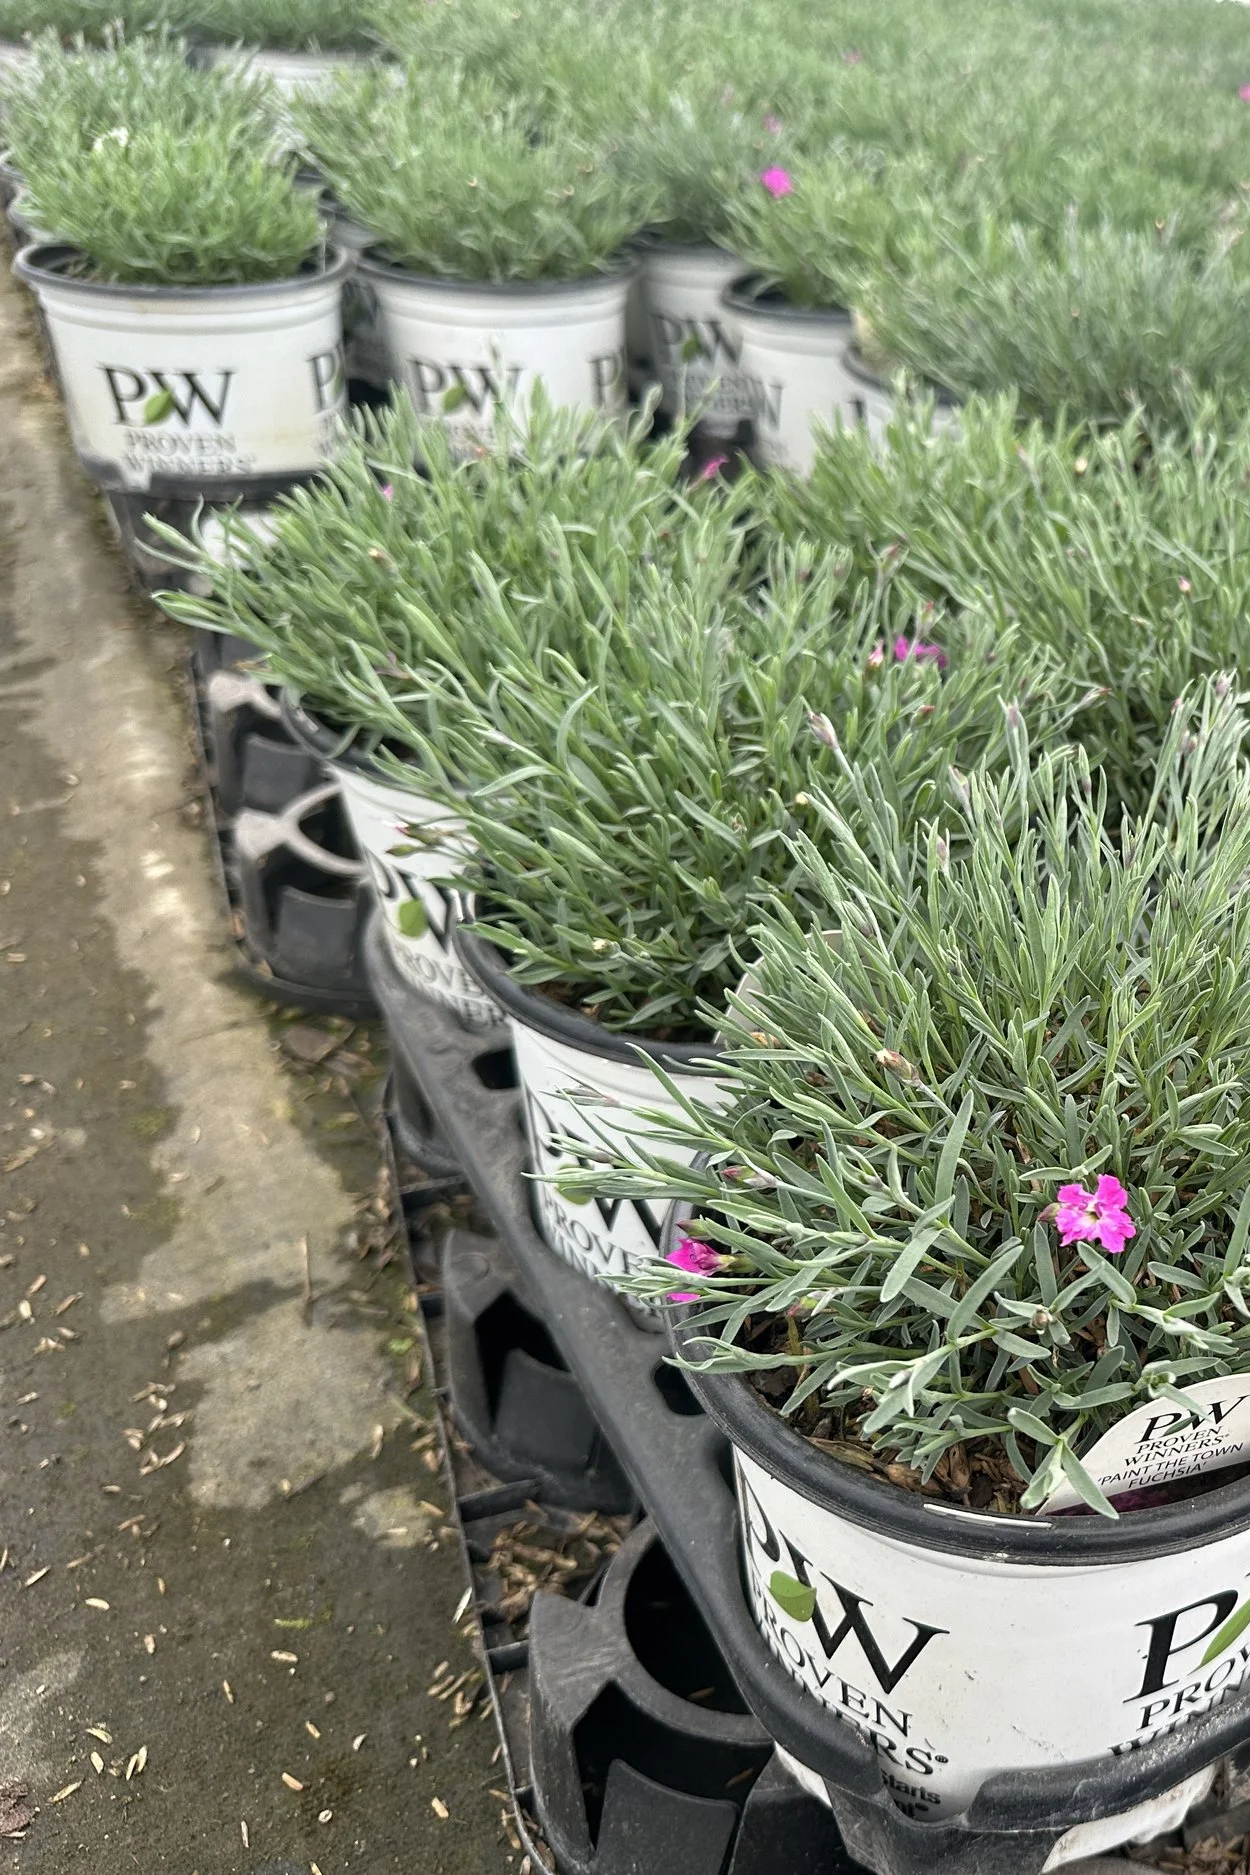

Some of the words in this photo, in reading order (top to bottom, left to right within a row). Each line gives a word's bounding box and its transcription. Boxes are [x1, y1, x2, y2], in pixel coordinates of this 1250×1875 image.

[97, 362, 237, 428] PW
[1137, 1426, 1222, 1454] PROVEN
[1156, 1456, 1188, 1471] THE
[1193, 1443, 1243, 1463] TOWN
